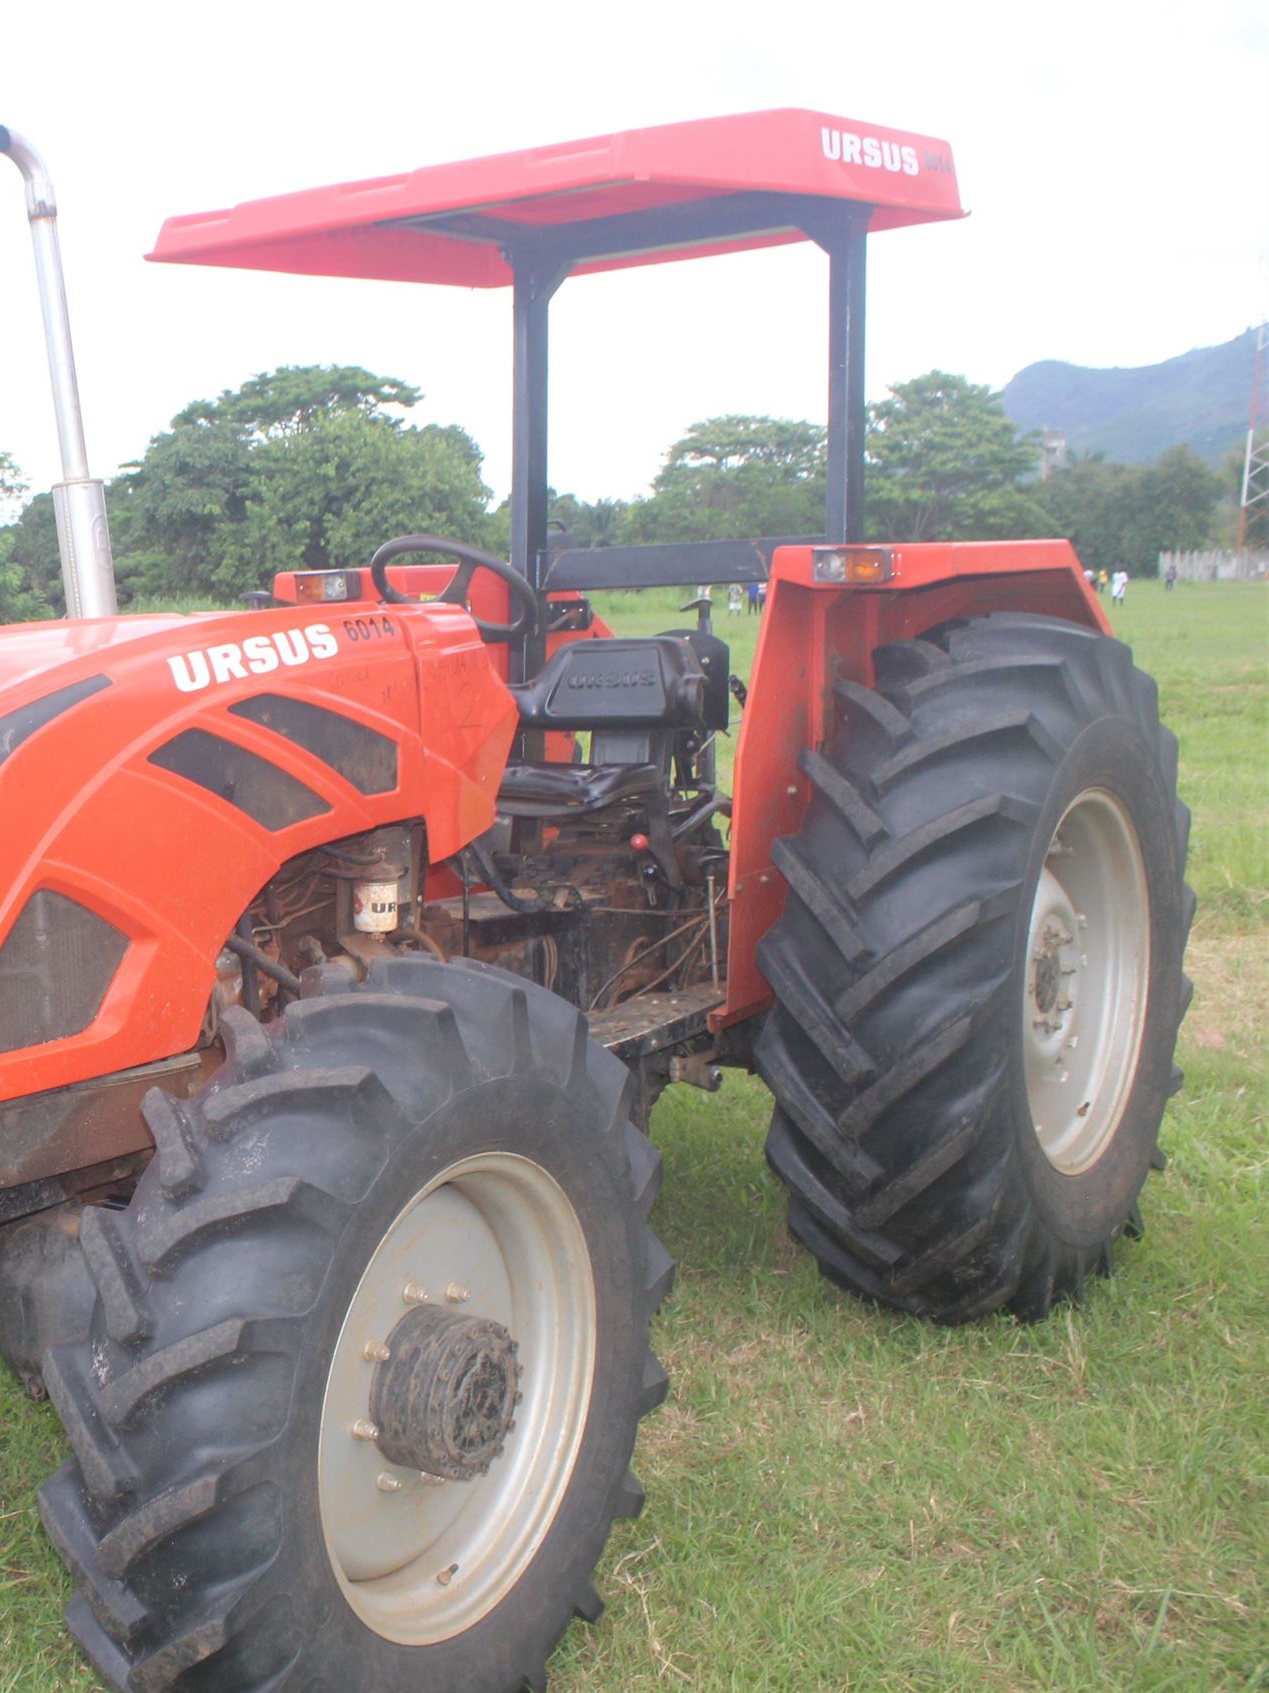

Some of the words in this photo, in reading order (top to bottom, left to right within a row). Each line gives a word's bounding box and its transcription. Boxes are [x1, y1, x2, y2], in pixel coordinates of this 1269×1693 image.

[821, 127, 919, 176] URSUS
[166, 624, 339, 693] URSUS
[343, 616, 395, 642] 6014
[567, 671, 656, 690] URSUS
